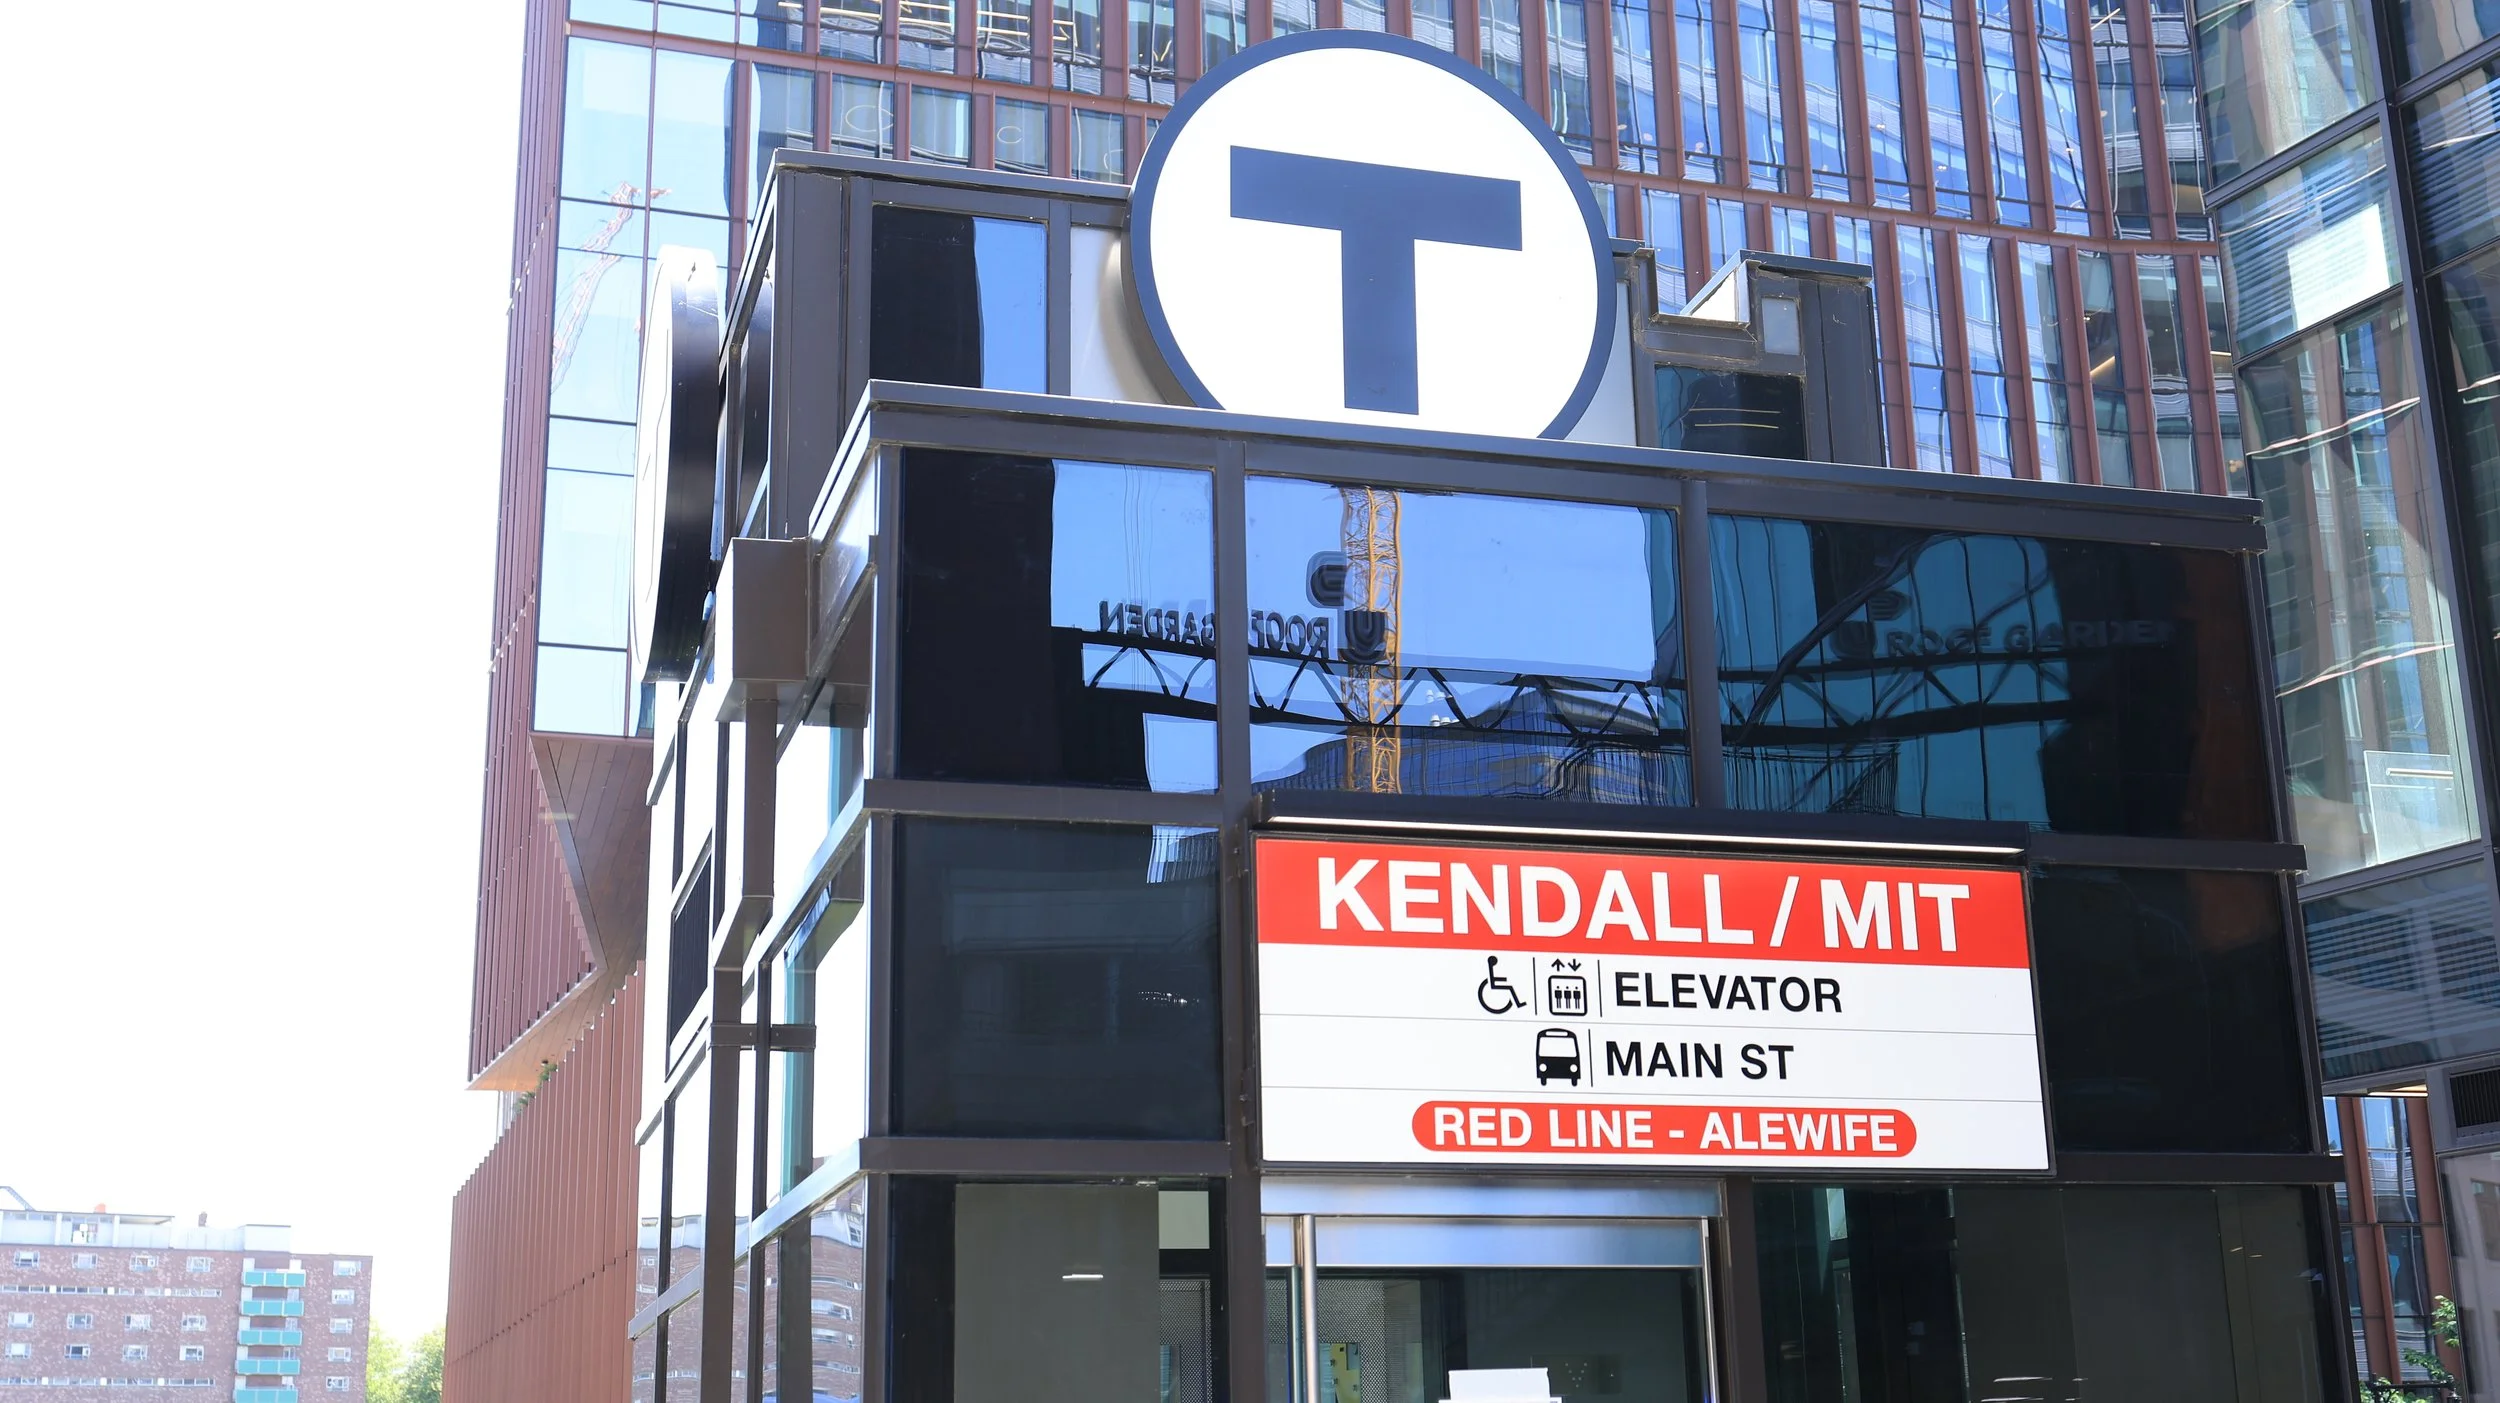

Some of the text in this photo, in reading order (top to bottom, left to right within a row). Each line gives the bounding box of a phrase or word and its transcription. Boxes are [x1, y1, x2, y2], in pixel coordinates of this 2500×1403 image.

[1230, 145, 1522, 415] T
[1317, 856, 1970, 952] KENDALL / MIT
[1615, 971, 1842, 1013] ELEVATOR
[1605, 1040, 1795, 1080] MAIN ST
[1433, 1106, 1533, 1147] RED
[1548, 1108, 1654, 1149] LINE
[1699, 1111, 1898, 1152] ALEWIFE
